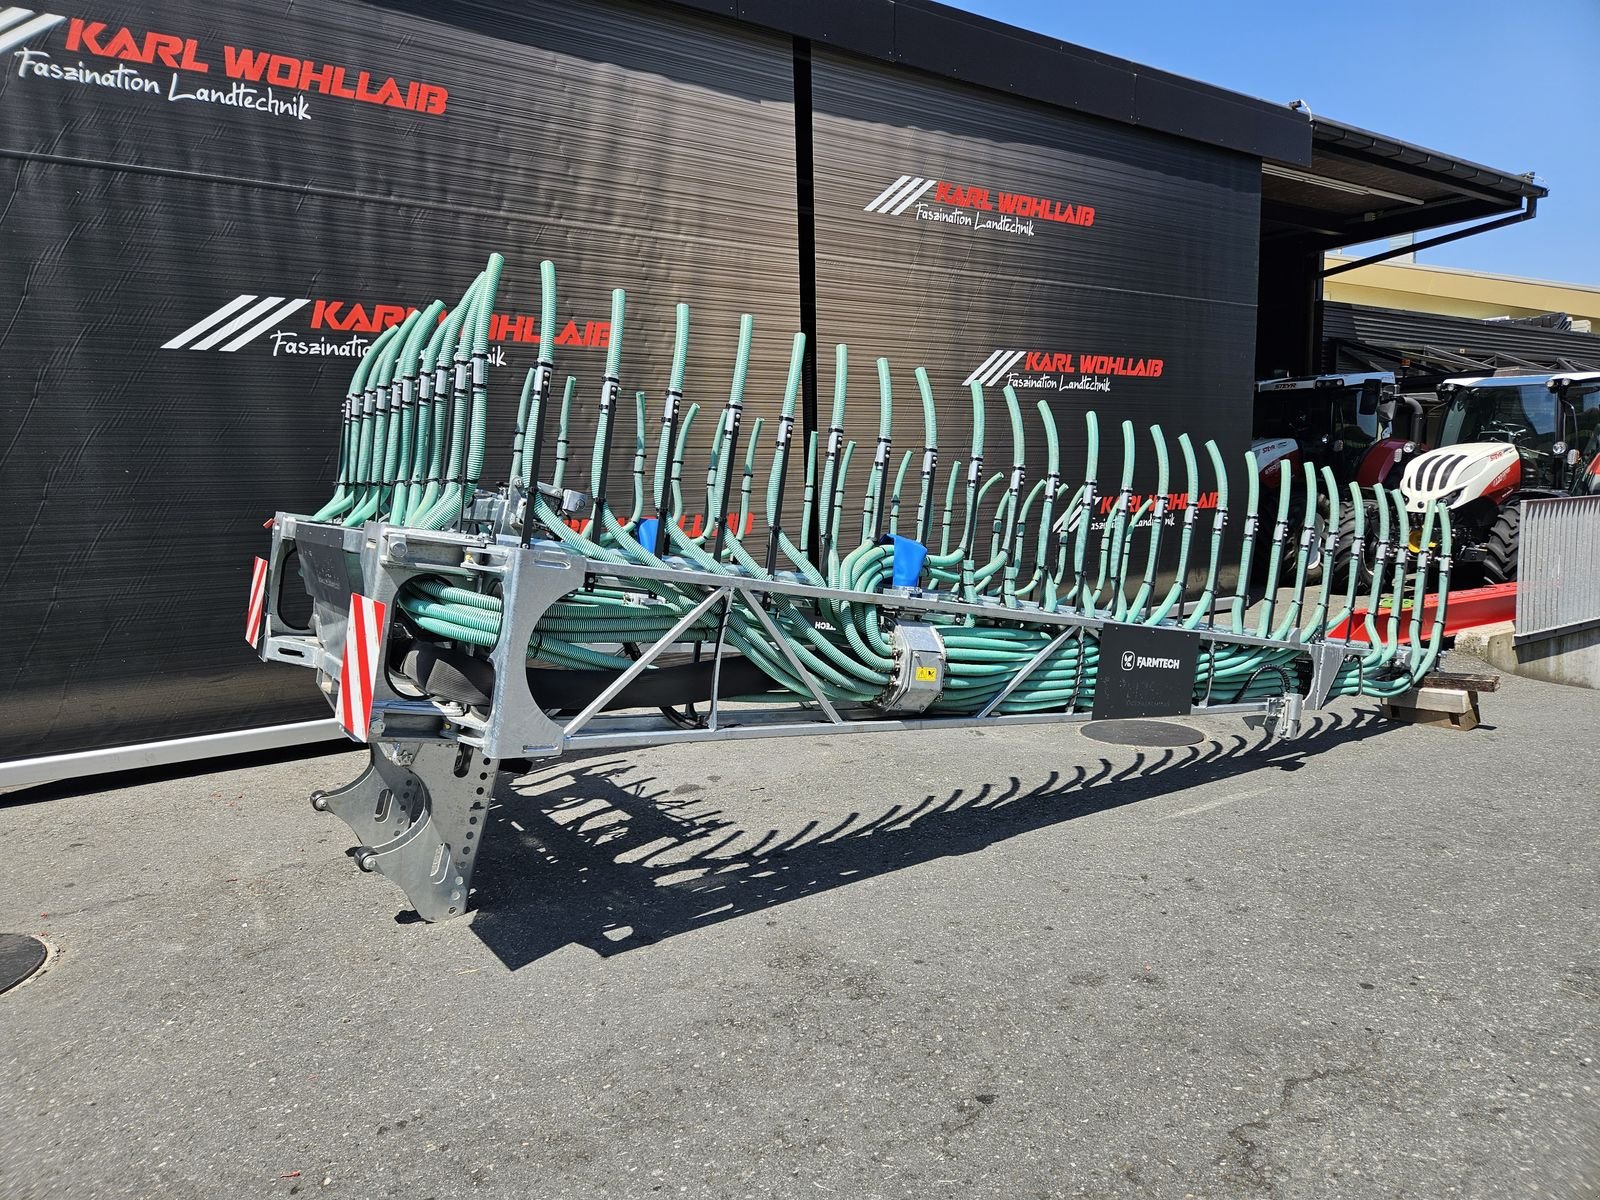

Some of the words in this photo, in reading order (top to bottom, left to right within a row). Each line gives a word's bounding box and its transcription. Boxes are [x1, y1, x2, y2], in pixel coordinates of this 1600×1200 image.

[65, 18, 209, 72] KARL
[14, 47, 160, 95] Faszination
[168, 72, 312, 121] Landtechnik
[934, 181, 993, 211] KARL
[915, 202, 972, 226] Faszination
[974, 211, 1035, 237] Landtechnik
[311, 300, 418, 333] KAR
[1024, 351, 1075, 373] KARL
[1006, 371, 1057, 389] Faszination
[1059, 374, 1111, 393] Landtechnik
[1136, 656, 1180, 670] FARMTECH
